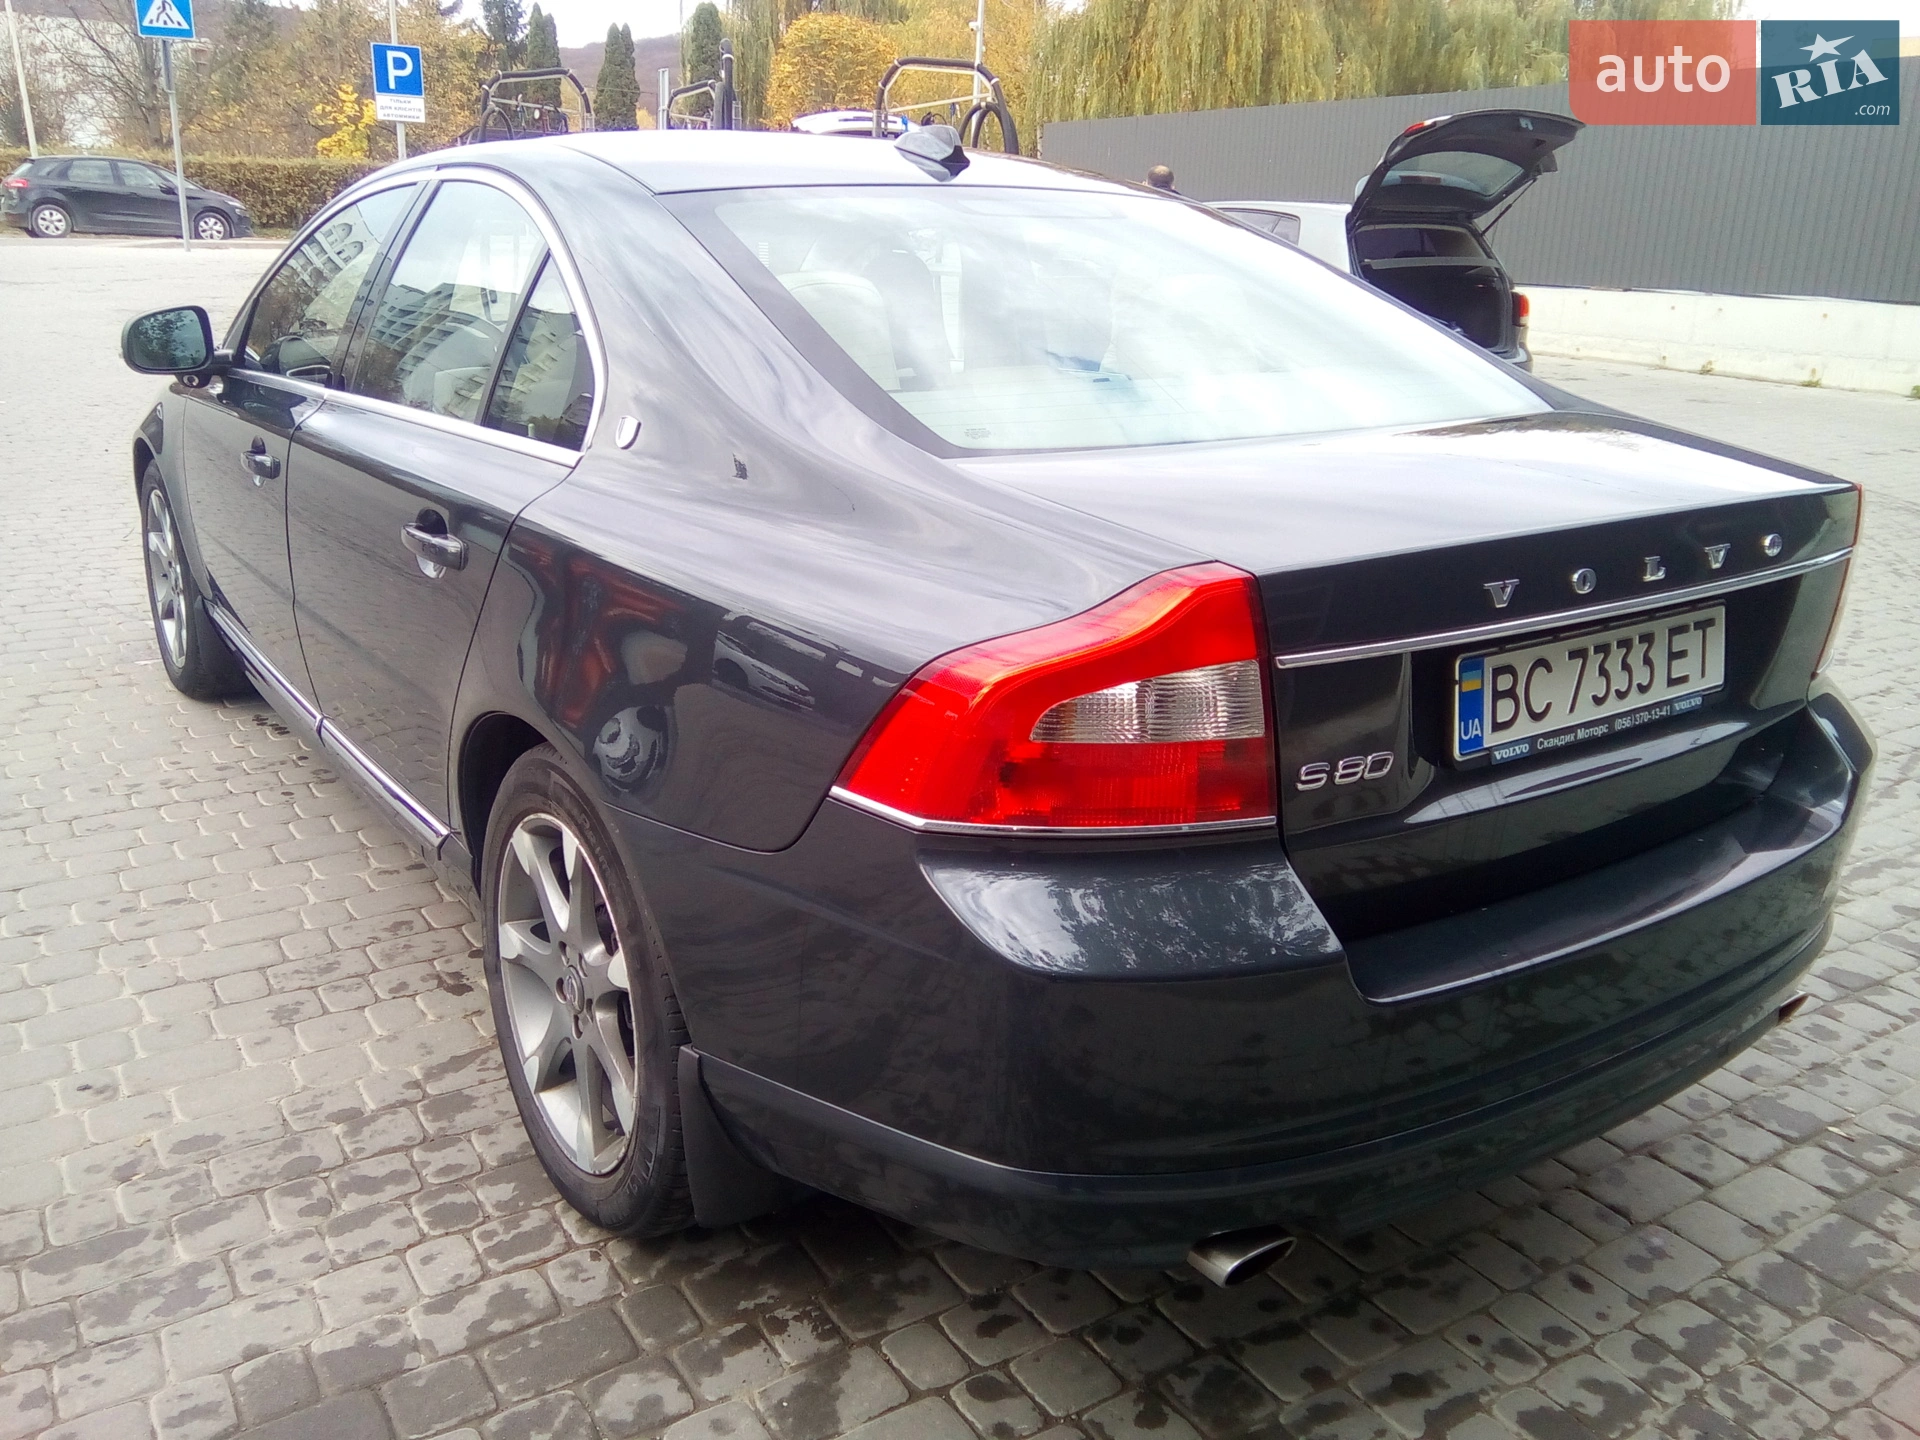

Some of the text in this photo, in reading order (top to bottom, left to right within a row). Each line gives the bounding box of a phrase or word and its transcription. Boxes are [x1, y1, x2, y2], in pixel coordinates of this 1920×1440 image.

[386, 50, 413, 90] P
[1483, 533, 1783, 608] VOLVO
[1489, 618, 1716, 734] BC 7333 ET
[1461, 717, 1482, 740] UA
[1494, 743, 1530, 761] VOLVO
[1537, 731, 1576, 750] Скандик
[1577, 723, 1609, 740] Моторс
[1674, 696, 1703, 711] VOLVO
[1296, 751, 1394, 791] S80
